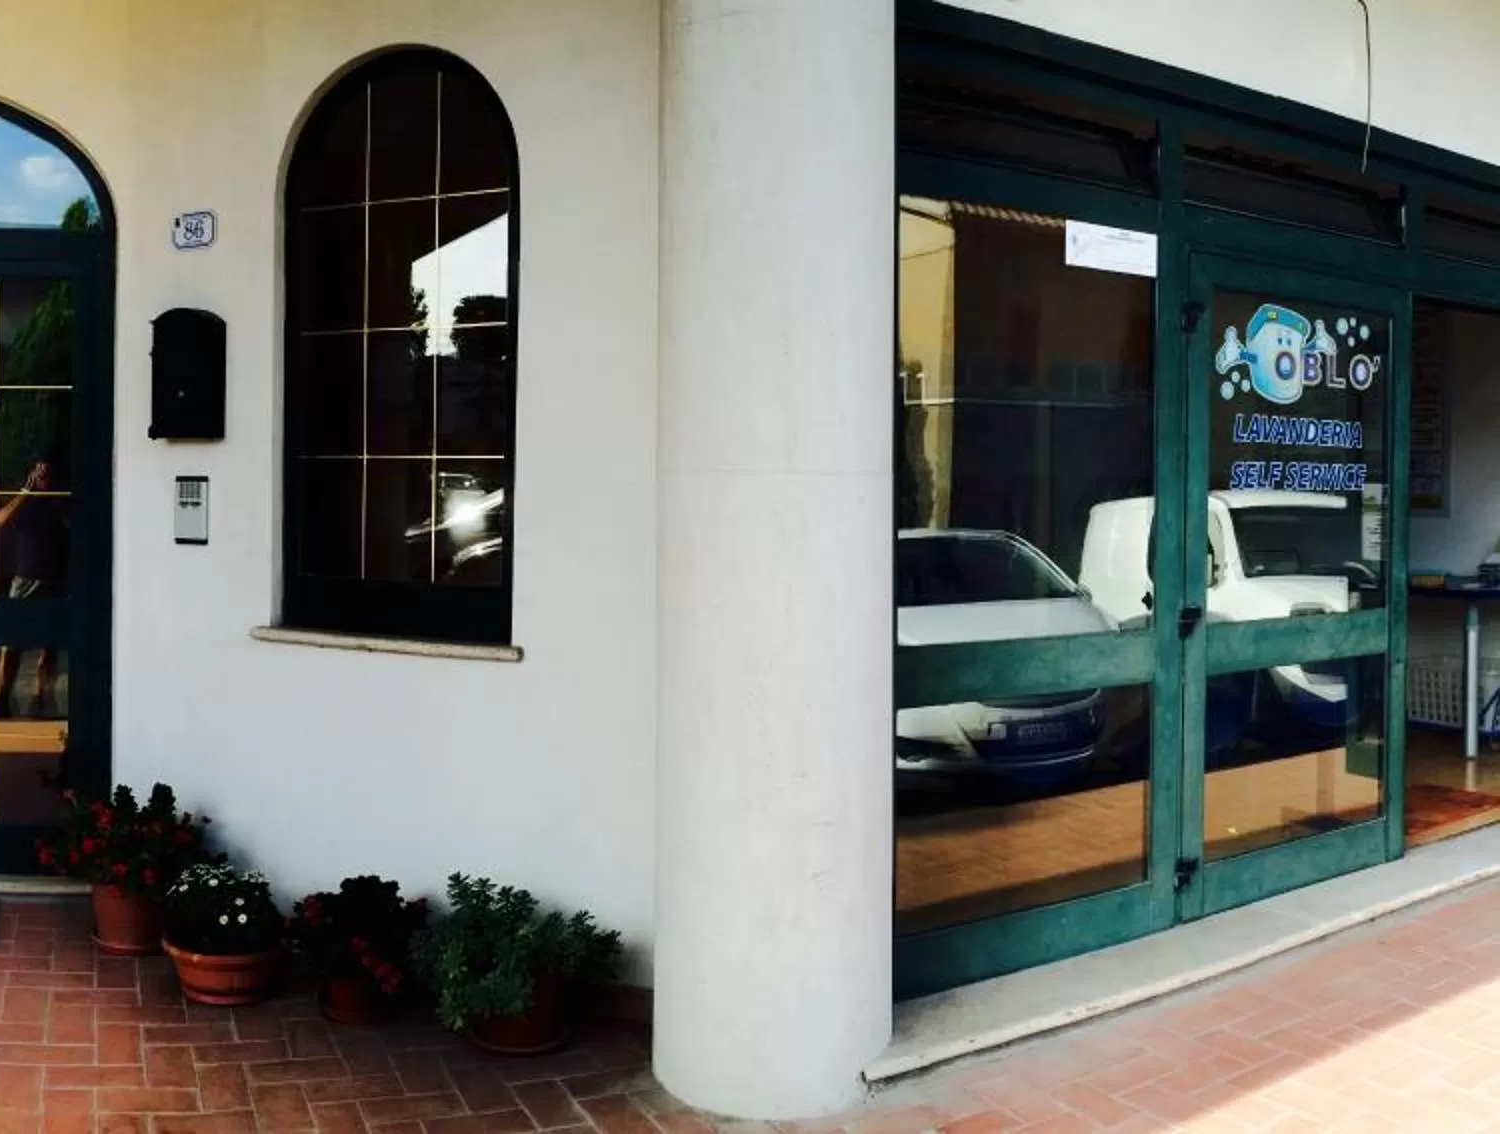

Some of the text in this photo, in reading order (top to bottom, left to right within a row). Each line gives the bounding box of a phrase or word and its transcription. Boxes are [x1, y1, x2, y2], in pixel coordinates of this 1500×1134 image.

[1233, 413, 1364, 449] LAVANDERIA
[1230, 461, 1367, 492] SELF SERVICE
